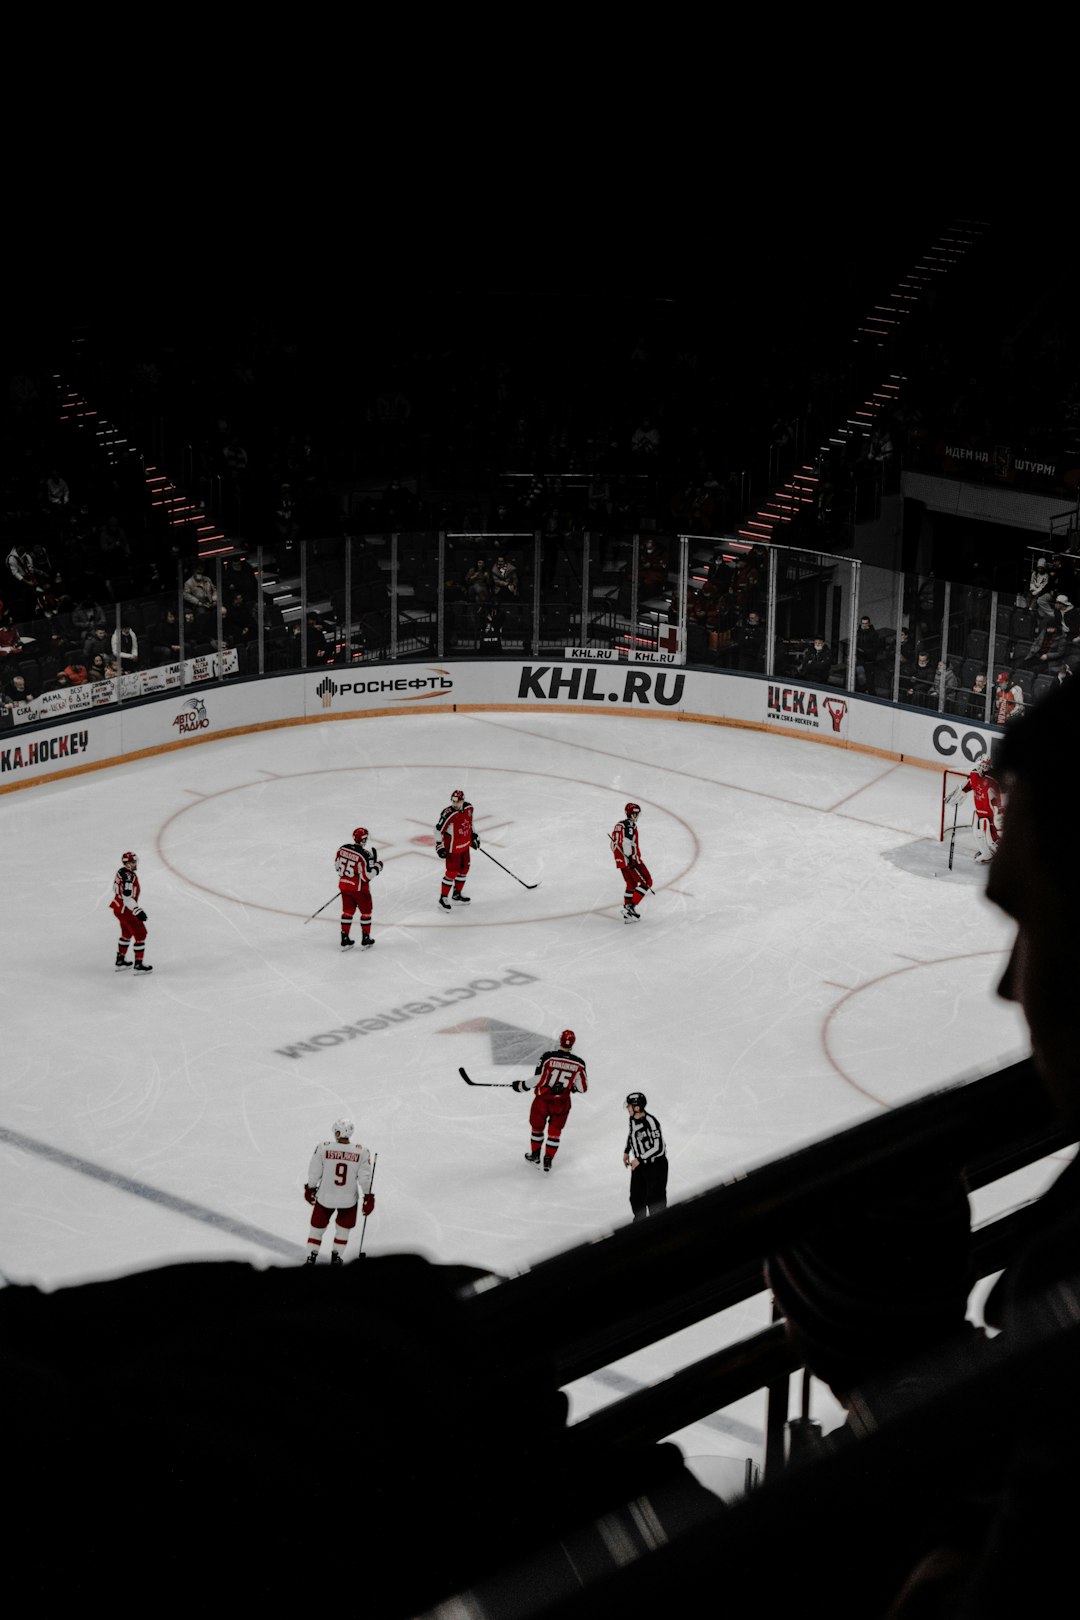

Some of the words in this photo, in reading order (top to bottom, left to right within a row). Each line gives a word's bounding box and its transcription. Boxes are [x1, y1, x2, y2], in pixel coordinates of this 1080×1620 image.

[975, 451, 989, 463] НА
[1014, 458, 1056, 476] ШТУРМ!
[571, 648, 612, 659] KHL.RU
[634, 652, 675, 663] KHL.RU
[70, 686, 82, 695] BEST
[339, 676, 454, 696] РОСНЕФТЬ
[517, 666, 686, 706] KHL.RU
[768, 685, 819, 717] ЦСКА
[172, 711, 197, 727] АВТО
[178, 717, 210, 735] РАДИО
[338, 857, 356, 878] 55
[274, 968, 541, 1060] Ростелеком
[548, 1068, 573, 1088] 15
[334, 1162, 348, 1187] 9
